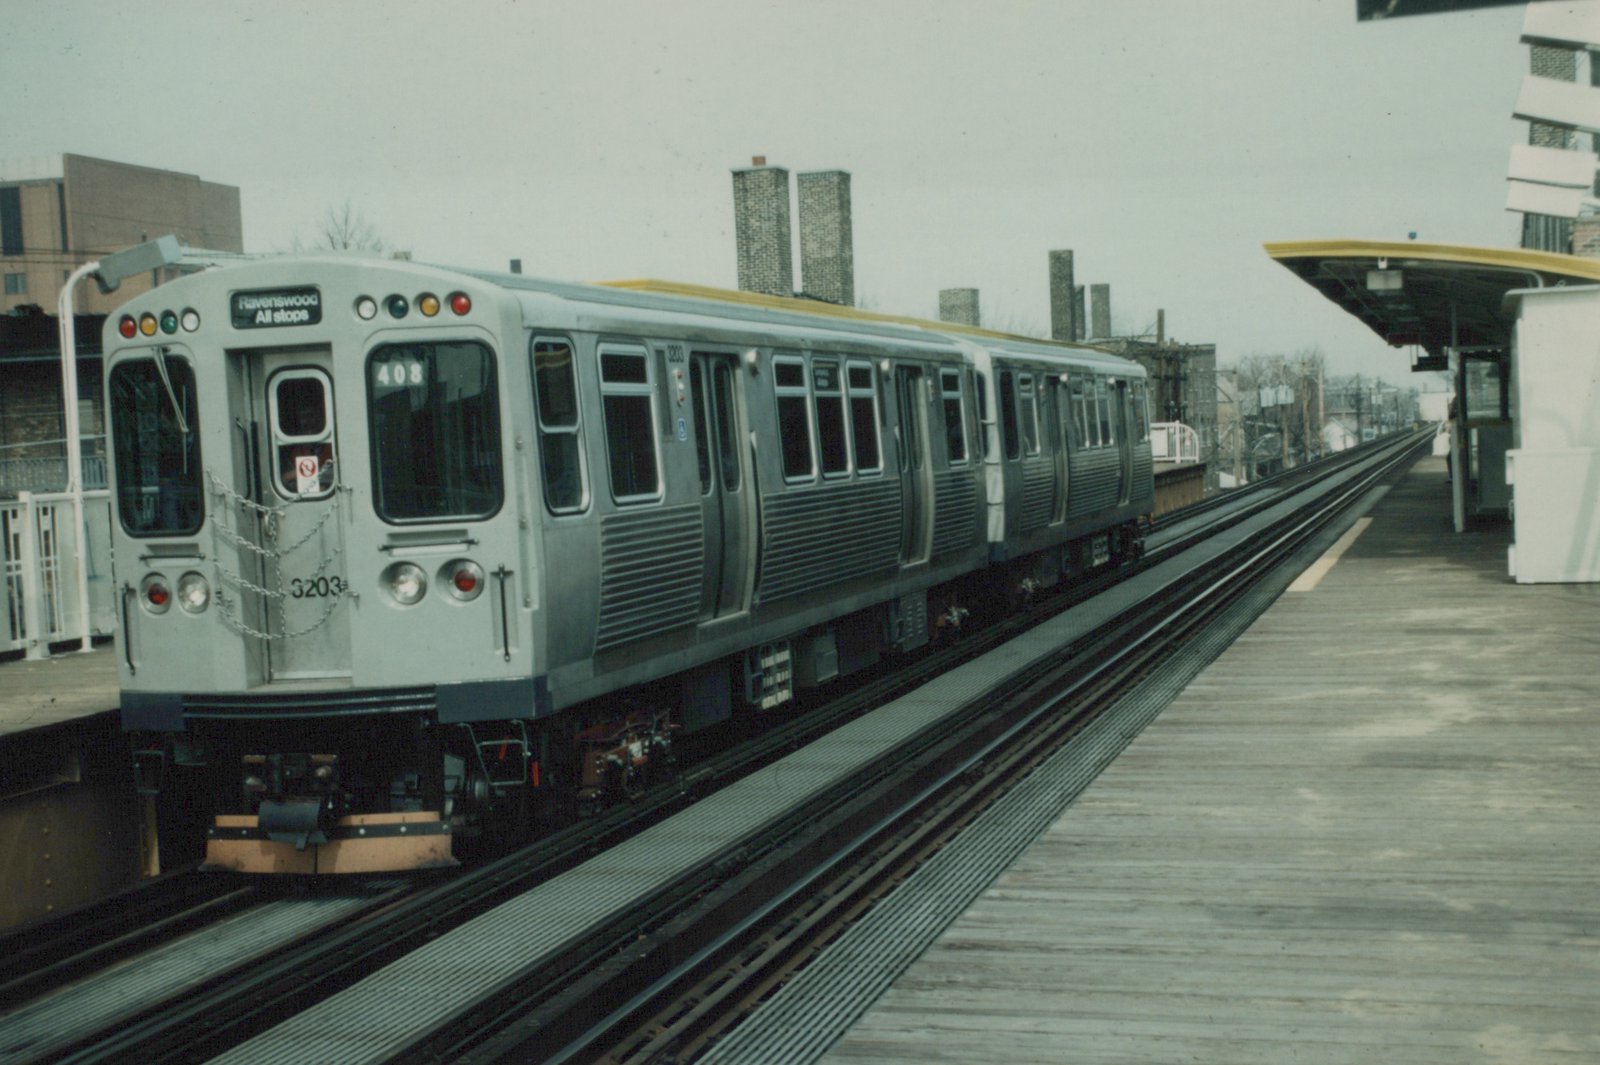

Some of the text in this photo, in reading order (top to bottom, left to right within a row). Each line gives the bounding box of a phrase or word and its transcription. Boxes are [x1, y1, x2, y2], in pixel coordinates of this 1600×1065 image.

[239, 294, 318, 309] Ravenswood
[256, 309, 309, 324] All stops
[378, 363, 422, 385] 408
[291, 575, 342, 599] 3203
